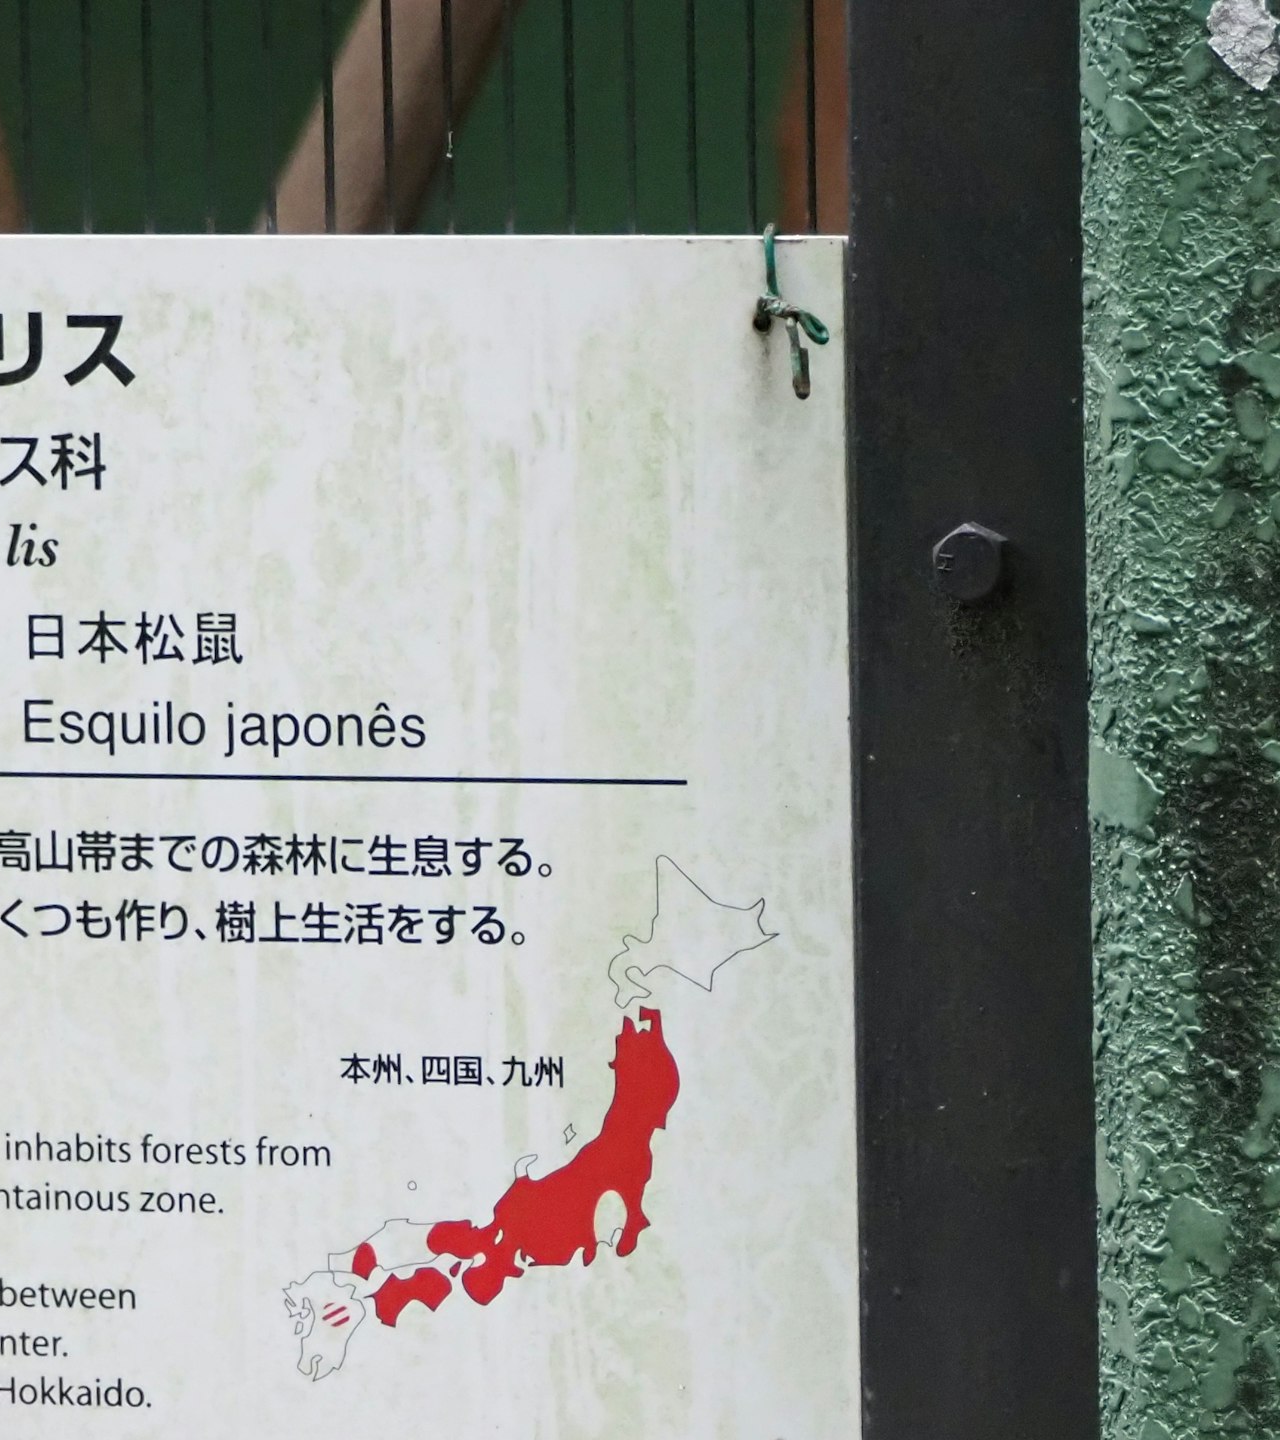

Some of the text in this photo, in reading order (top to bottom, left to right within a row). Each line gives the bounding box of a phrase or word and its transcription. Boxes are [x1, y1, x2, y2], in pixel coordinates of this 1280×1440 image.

[6, 522, 60, 568] lis
[27, 609, 244, 666] 日本松鼠
[23, 698, 427, 759] Esquilo japonês
[339, 1052, 564, 1089] 本州、四国、九州
[5, 1131, 132, 1164] inhabits
[139, 1133, 247, 1166] forests
[255, 1135, 331, 1168] from
[138, 1191, 224, 1215] zone.
